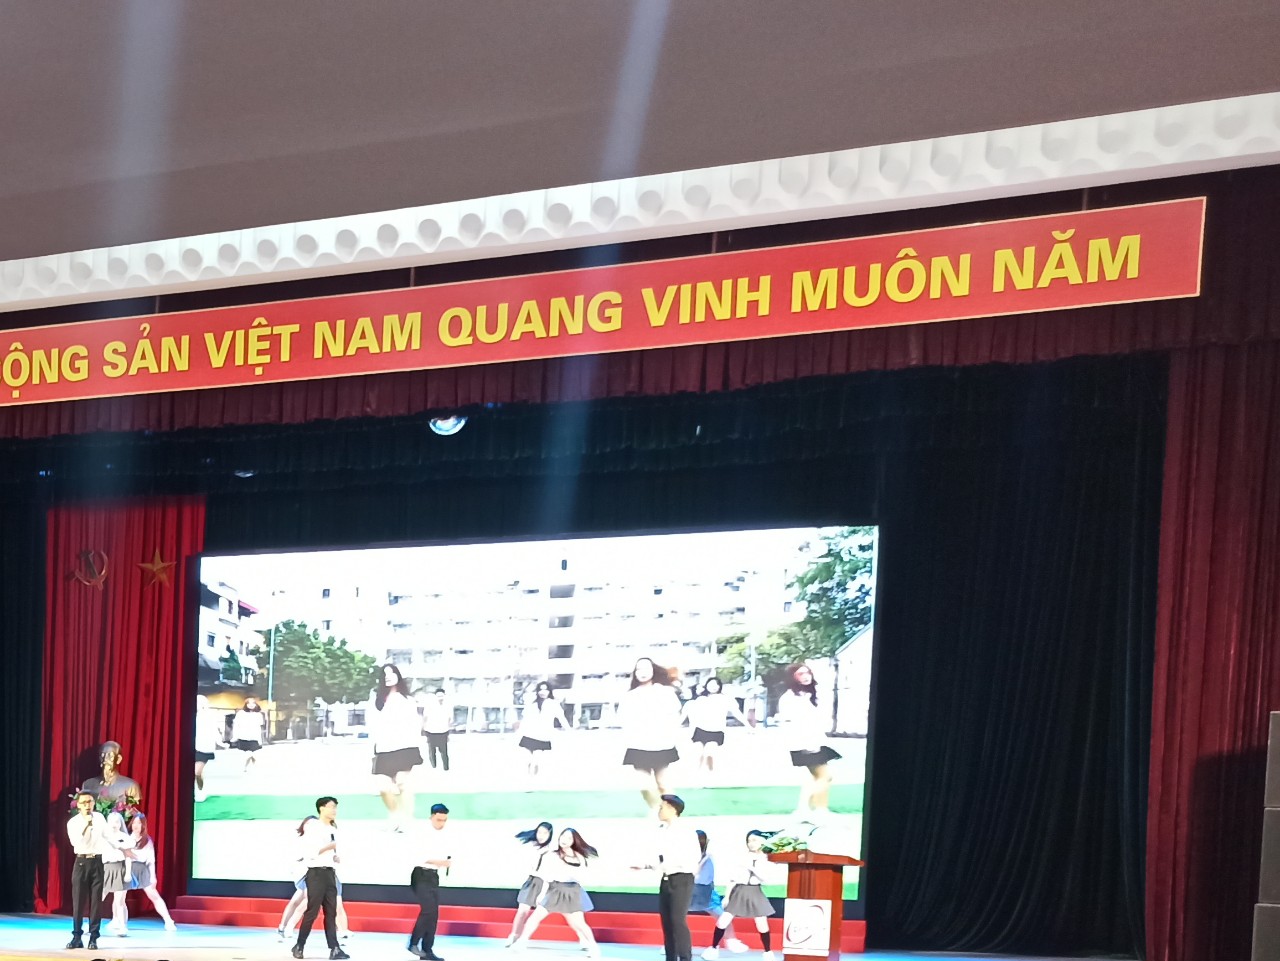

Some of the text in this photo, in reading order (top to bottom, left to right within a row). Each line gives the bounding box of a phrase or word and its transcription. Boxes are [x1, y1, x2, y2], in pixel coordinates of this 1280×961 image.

[103, 323, 190, 378] SẢN
[204, 317, 300, 376] VIỆT
[313, 311, 422, 359] NAM
[438, 291, 623, 347] QUANG
[641, 274, 772, 327] VINH
[790, 247, 972, 313] MUÔN
[992, 228, 1141, 293] NĂM
